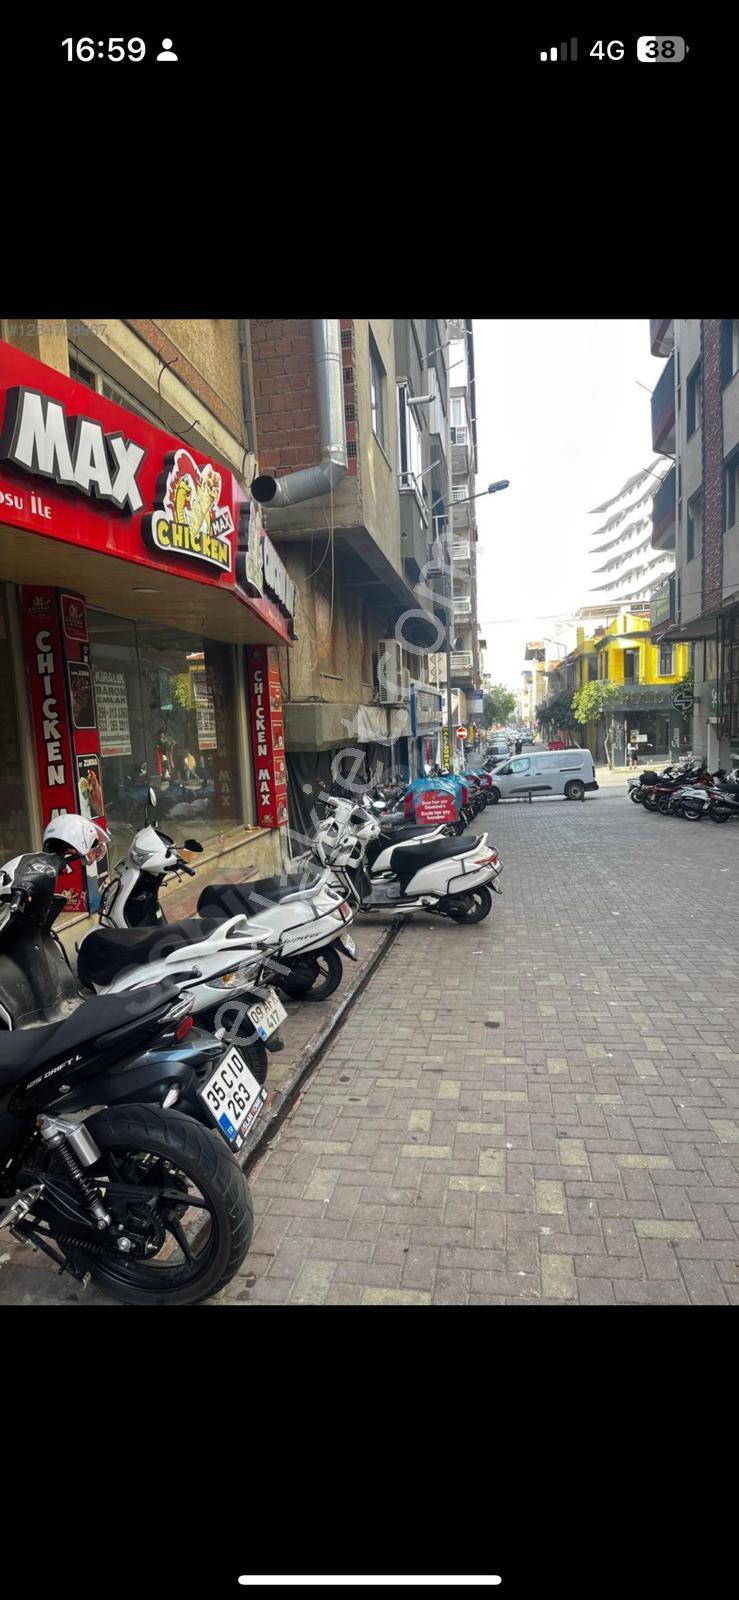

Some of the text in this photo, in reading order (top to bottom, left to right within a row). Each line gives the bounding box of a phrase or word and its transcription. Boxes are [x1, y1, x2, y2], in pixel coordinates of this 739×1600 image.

[13, 390, 147, 513] MAX
[212, 511, 232, 536] MAX
[156, 518, 229, 564] CHICKEN
[35, 630, 65, 786] CHICKEN
[95, 686, 127, 697] BARON
[254, 670, 271, 806] CHICKEN MAX
[250, 1006, 264, 1024] 09
[267, 1009, 281, 1030] 417
[207, 1081, 226, 1110] 35
[227, 1083, 251, 1121] 263
